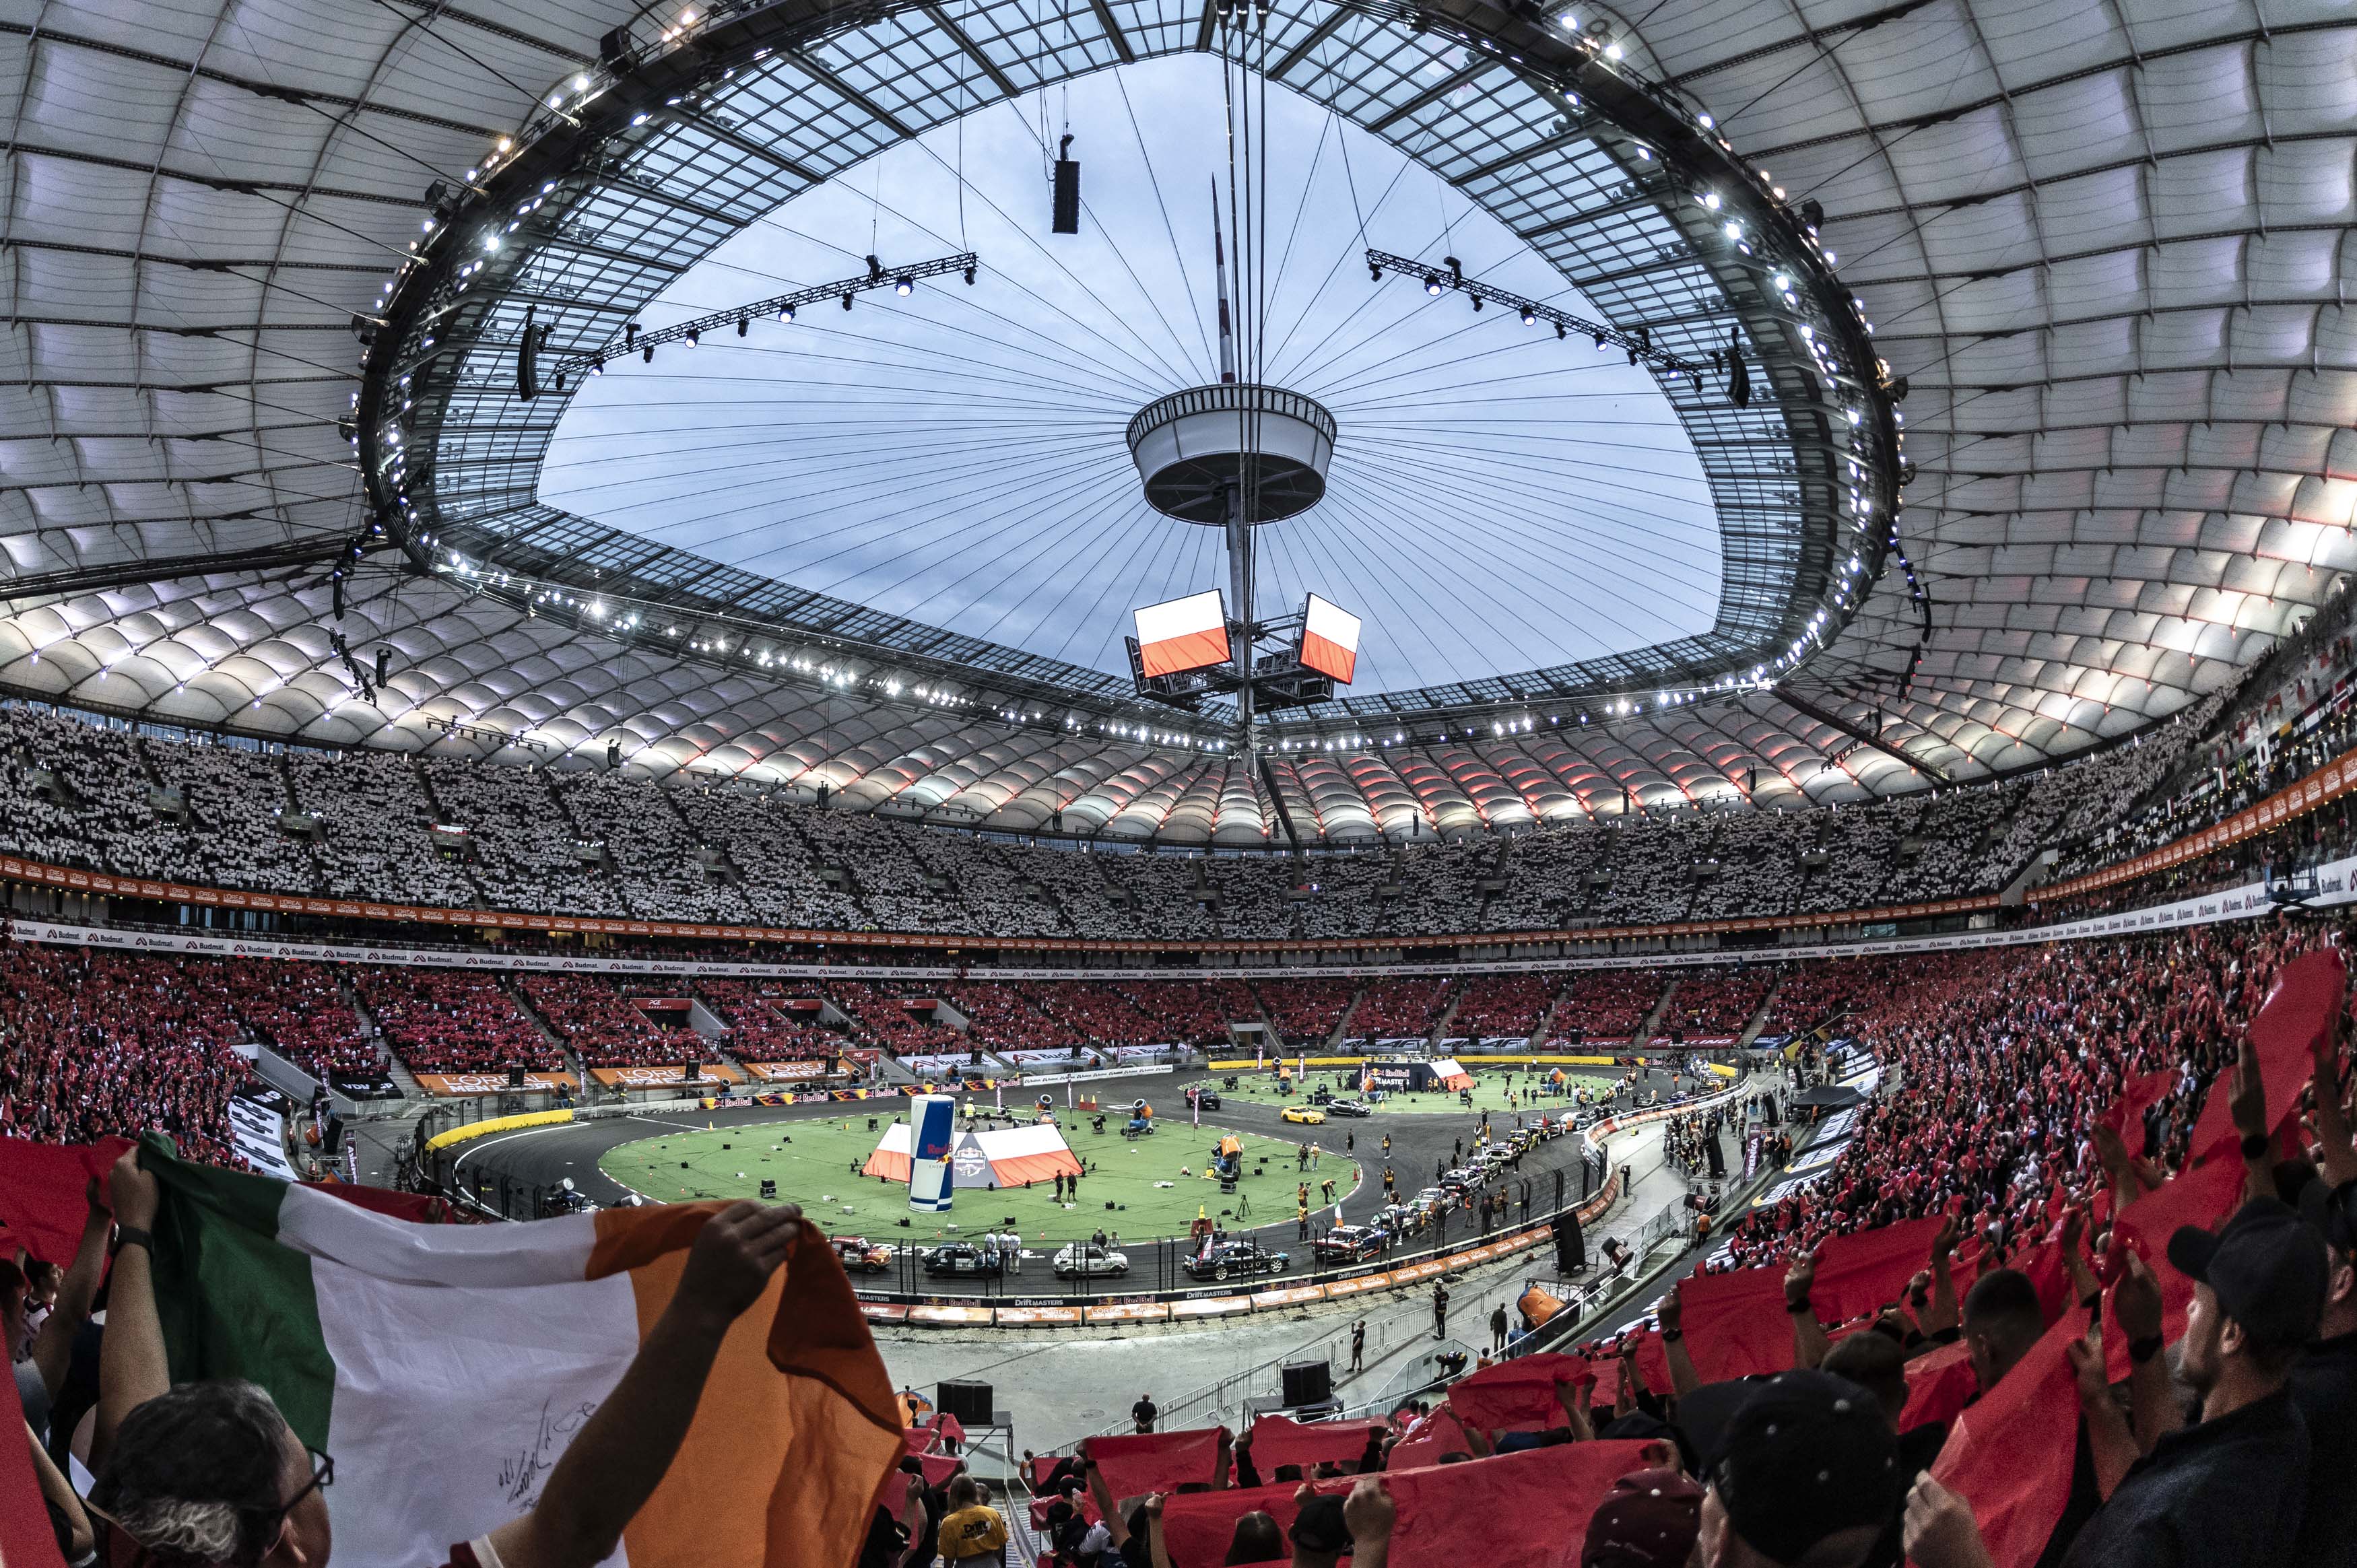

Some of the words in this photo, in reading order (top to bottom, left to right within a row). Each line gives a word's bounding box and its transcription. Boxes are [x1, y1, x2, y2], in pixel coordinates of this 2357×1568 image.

[1351, 1269, 1374, 1278] MASTERS
[1285, 1280, 1298, 1289] Red
[1298, 1278, 1312, 1287] Bull
[1123, 1296, 1138, 1304] Red
[1138, 1295, 1156, 1303] Bull
[1187, 1291, 1203, 1299] Drift
[949, 1299, 964, 1307] Red
[964, 1299, 981, 1307] Bull
[964, 1520, 987, 1533] Drift
